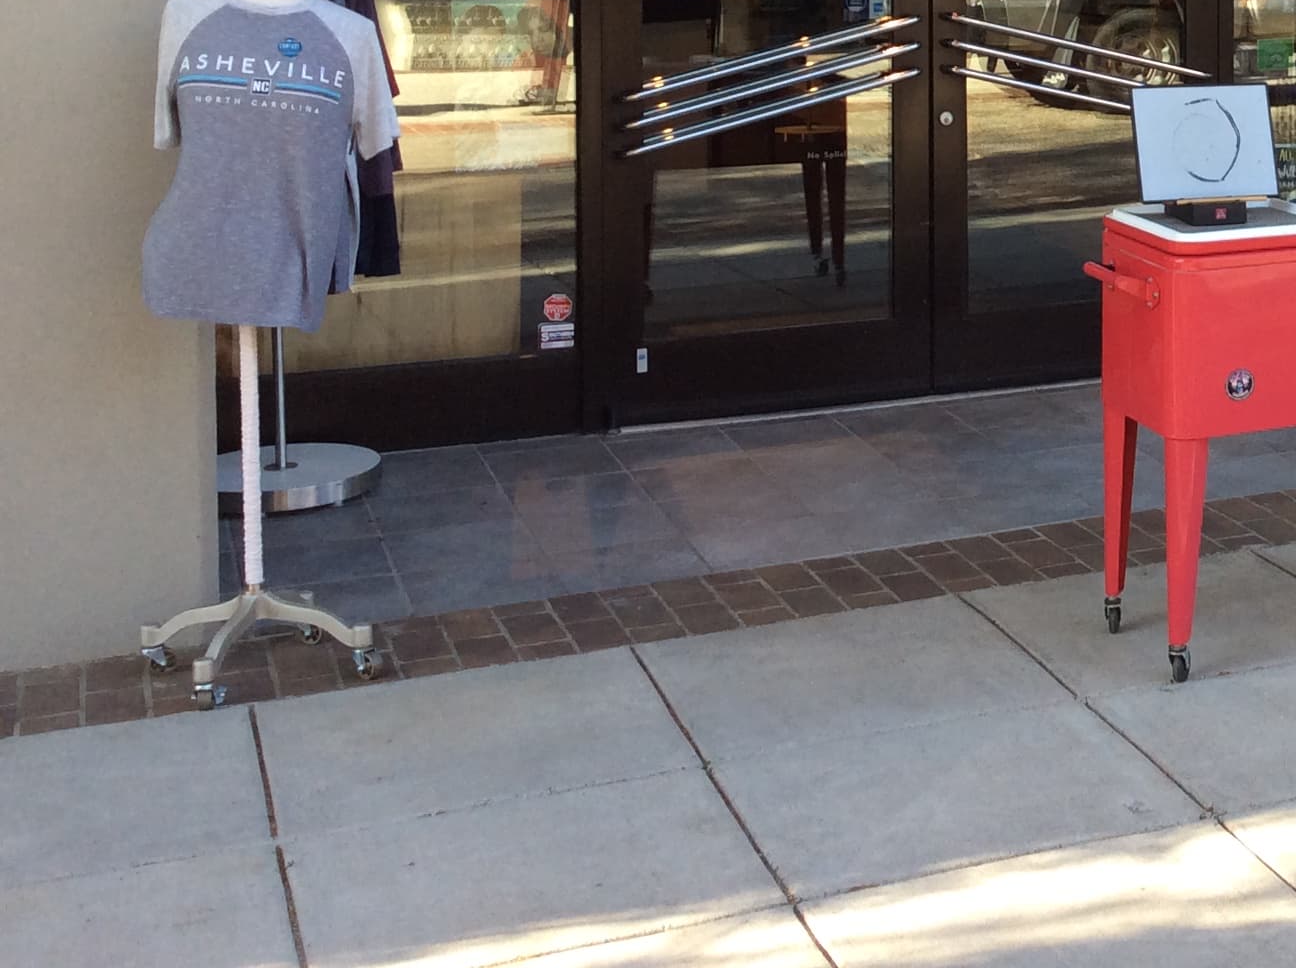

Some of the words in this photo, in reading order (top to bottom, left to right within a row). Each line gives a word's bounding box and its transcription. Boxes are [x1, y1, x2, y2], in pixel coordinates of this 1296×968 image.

[179, 53, 346, 88] ASHEVILLE
[252, 79, 271, 94] NC
[194, 95, 241, 106] NORTH
[251, 99, 320, 114] CAROLINA
